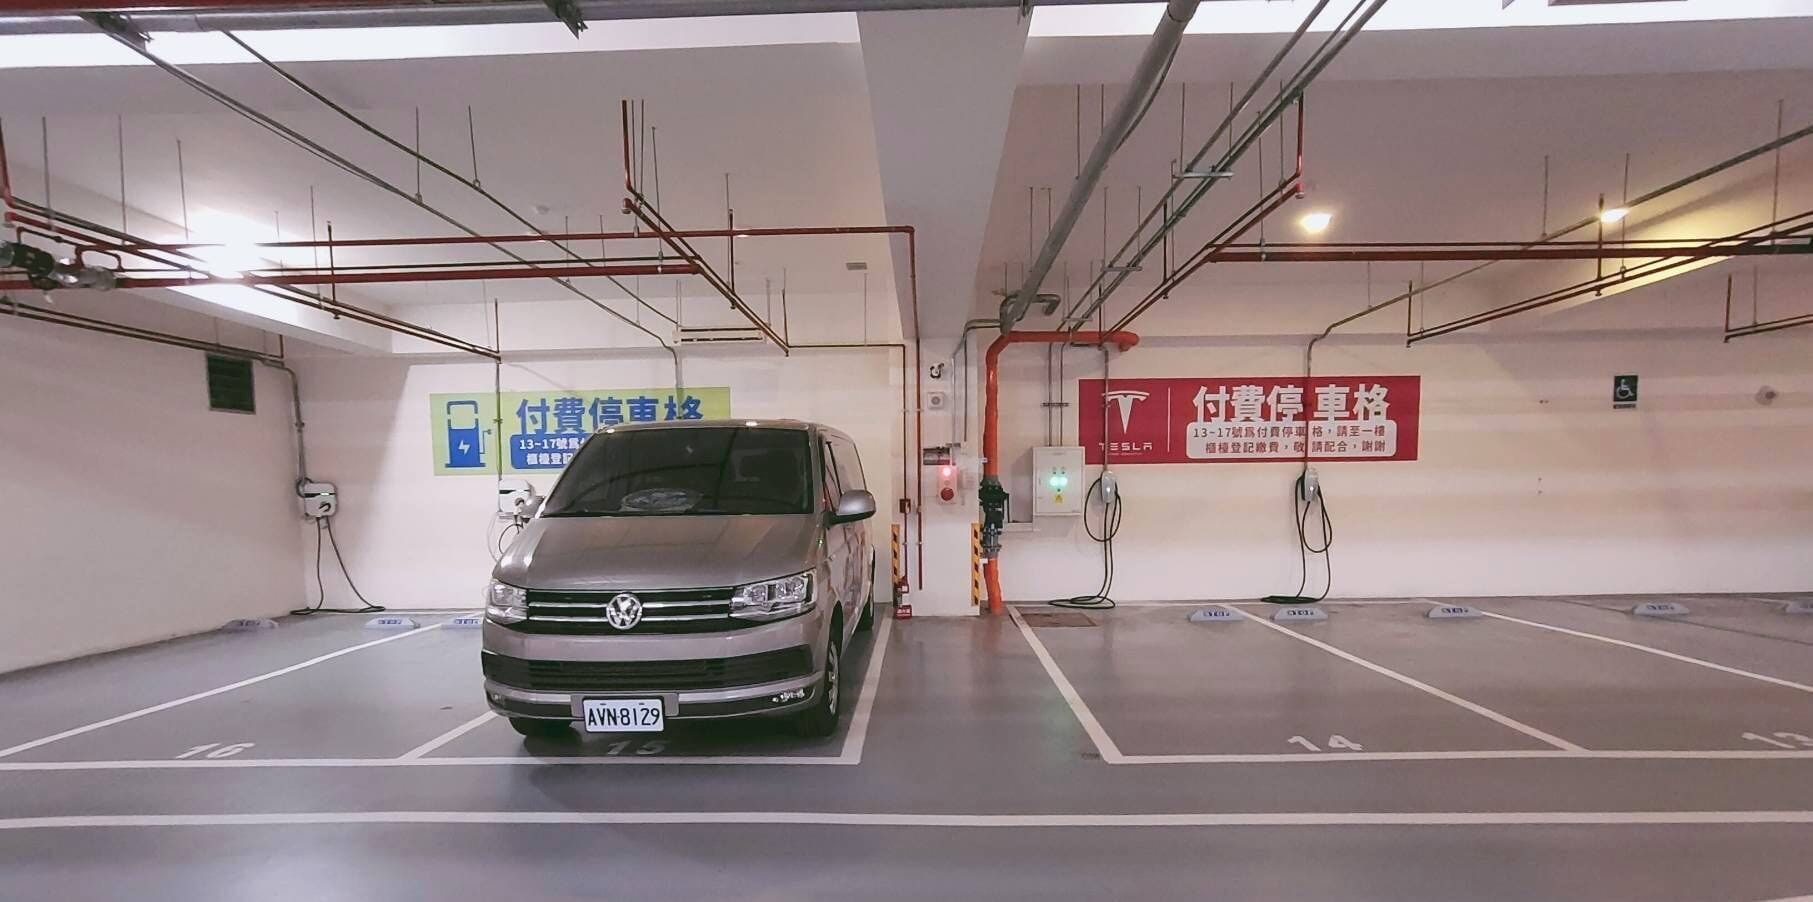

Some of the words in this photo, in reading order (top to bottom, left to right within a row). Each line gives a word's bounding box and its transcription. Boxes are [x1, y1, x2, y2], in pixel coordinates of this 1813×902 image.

[1192, 383, 1391, 423] 付費停車格
[1098, 442, 1153, 451] TESLA
[175, 742, 256, 759] 16
[607, 739, 671, 755] 15
[1287, 734, 1363, 752] 14
